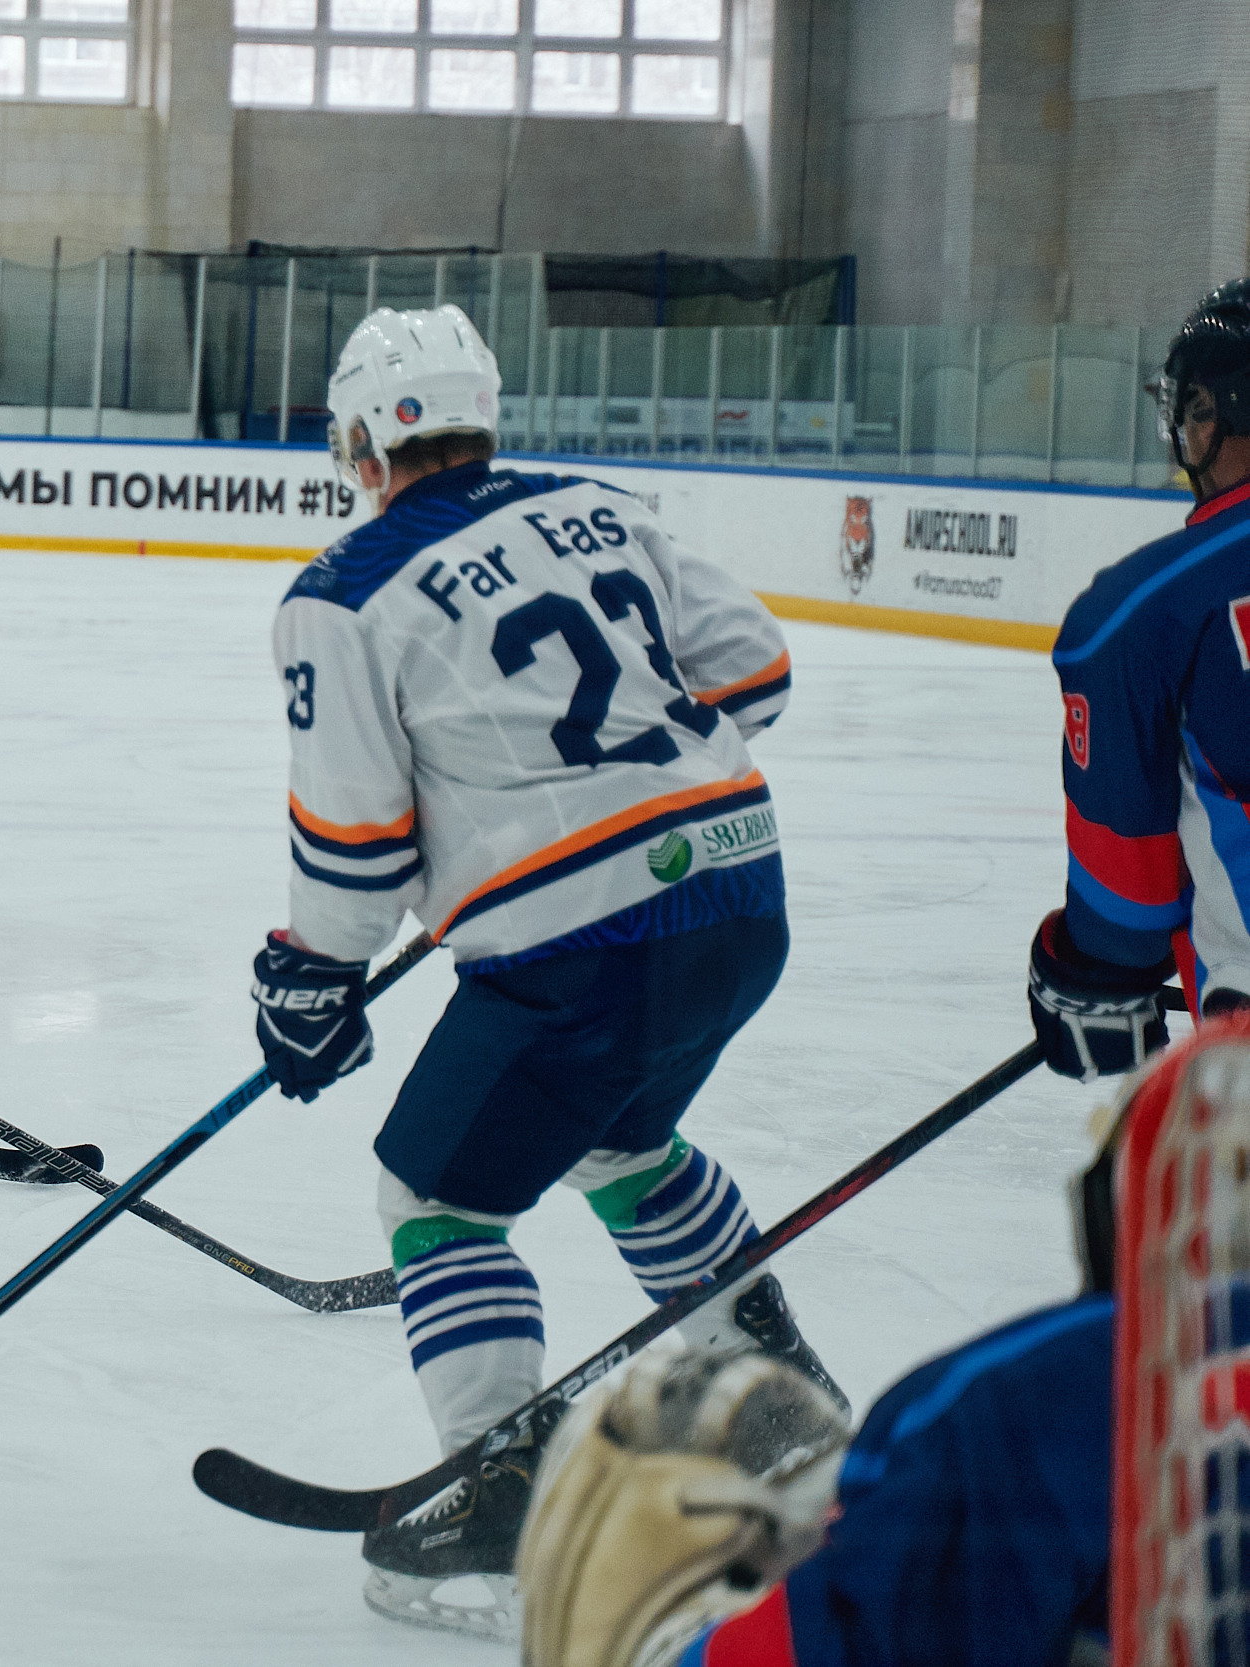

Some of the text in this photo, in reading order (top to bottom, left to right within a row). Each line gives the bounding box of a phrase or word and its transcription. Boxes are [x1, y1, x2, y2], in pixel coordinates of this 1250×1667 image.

[90, 472, 286, 515] ПОМНИМ
[904, 507, 1018, 558] AMURSCHOOL.RU
[417, 543, 519, 623] Far
[491, 568, 720, 768] 23
